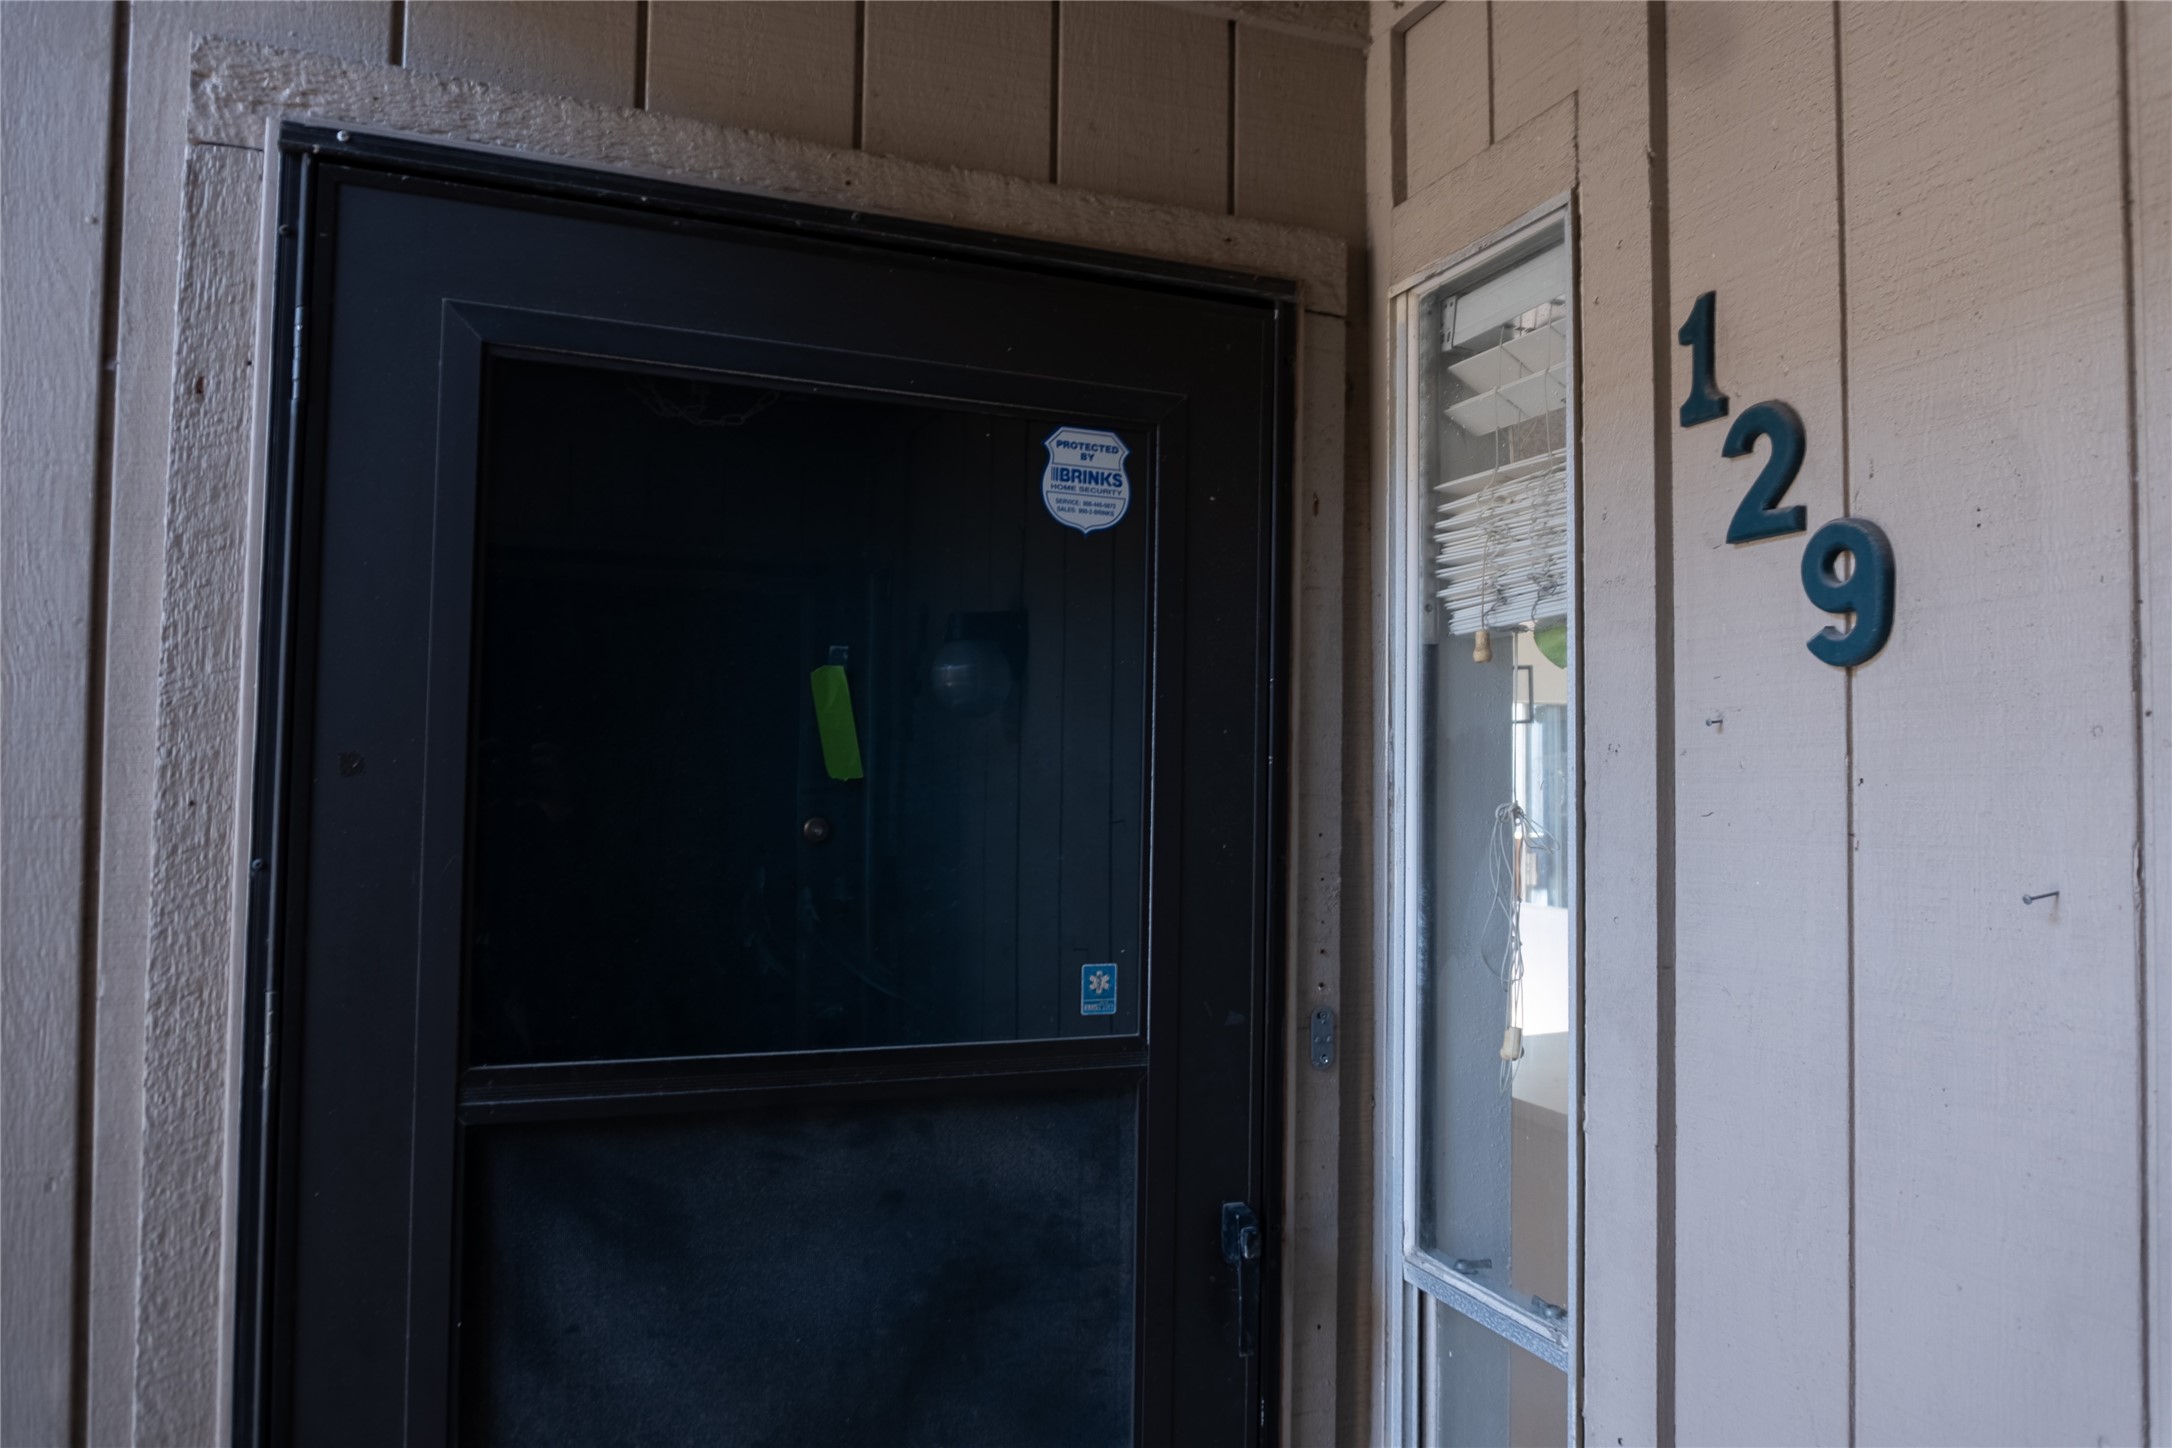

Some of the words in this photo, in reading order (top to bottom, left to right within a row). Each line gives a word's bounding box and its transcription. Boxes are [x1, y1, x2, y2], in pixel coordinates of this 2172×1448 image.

[1056, 440, 1119, 455] PROTECTED
[1080, 452, 1096, 462] BY
[1059, 467, 1123, 488] BRINKS
[1050, 482, 1077, 492] HOME
[1078, 486, 1123, 497] SECURITY
